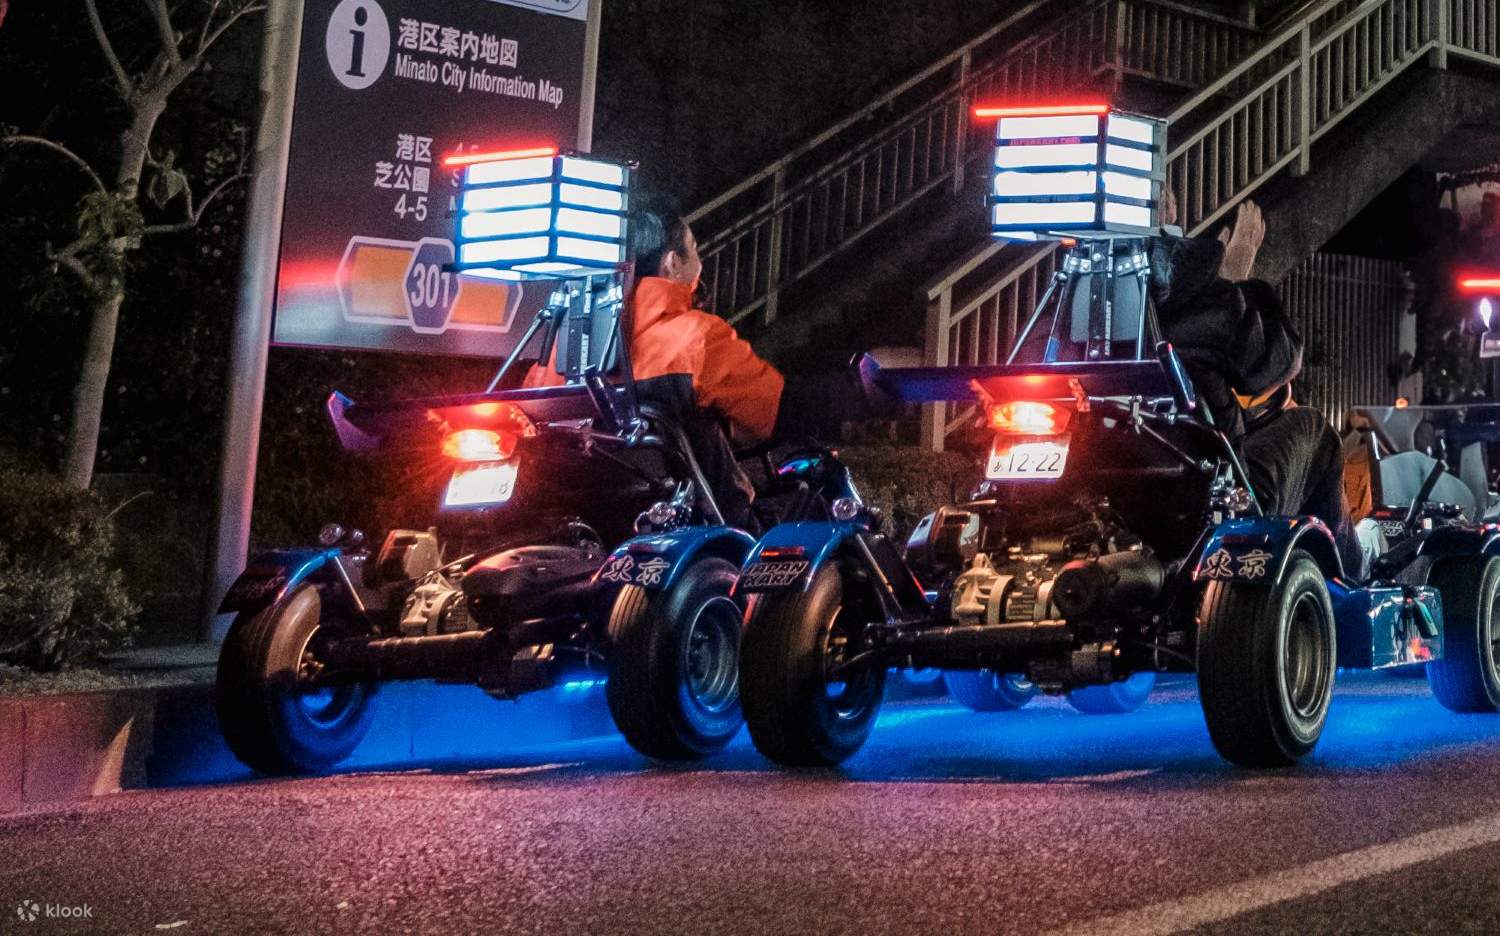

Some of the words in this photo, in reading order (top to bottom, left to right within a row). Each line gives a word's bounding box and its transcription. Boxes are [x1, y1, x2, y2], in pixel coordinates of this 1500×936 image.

[397, 17, 519, 69] 港区案内地図
[395, 53, 438, 83] Minato
[441, 61, 467, 93] City
[469, 67, 536, 100] Information
[538, 79, 563, 109] Map
[395, 134, 434, 163] 港区
[374, 161, 431, 194] 芝公園
[394, 193, 428, 221] 4-5
[411, 263, 451, 309] 301
[602, 555, 671, 585] 東京
[743, 572, 796, 588] KART
[1200, 548, 1274, 580] 東京
